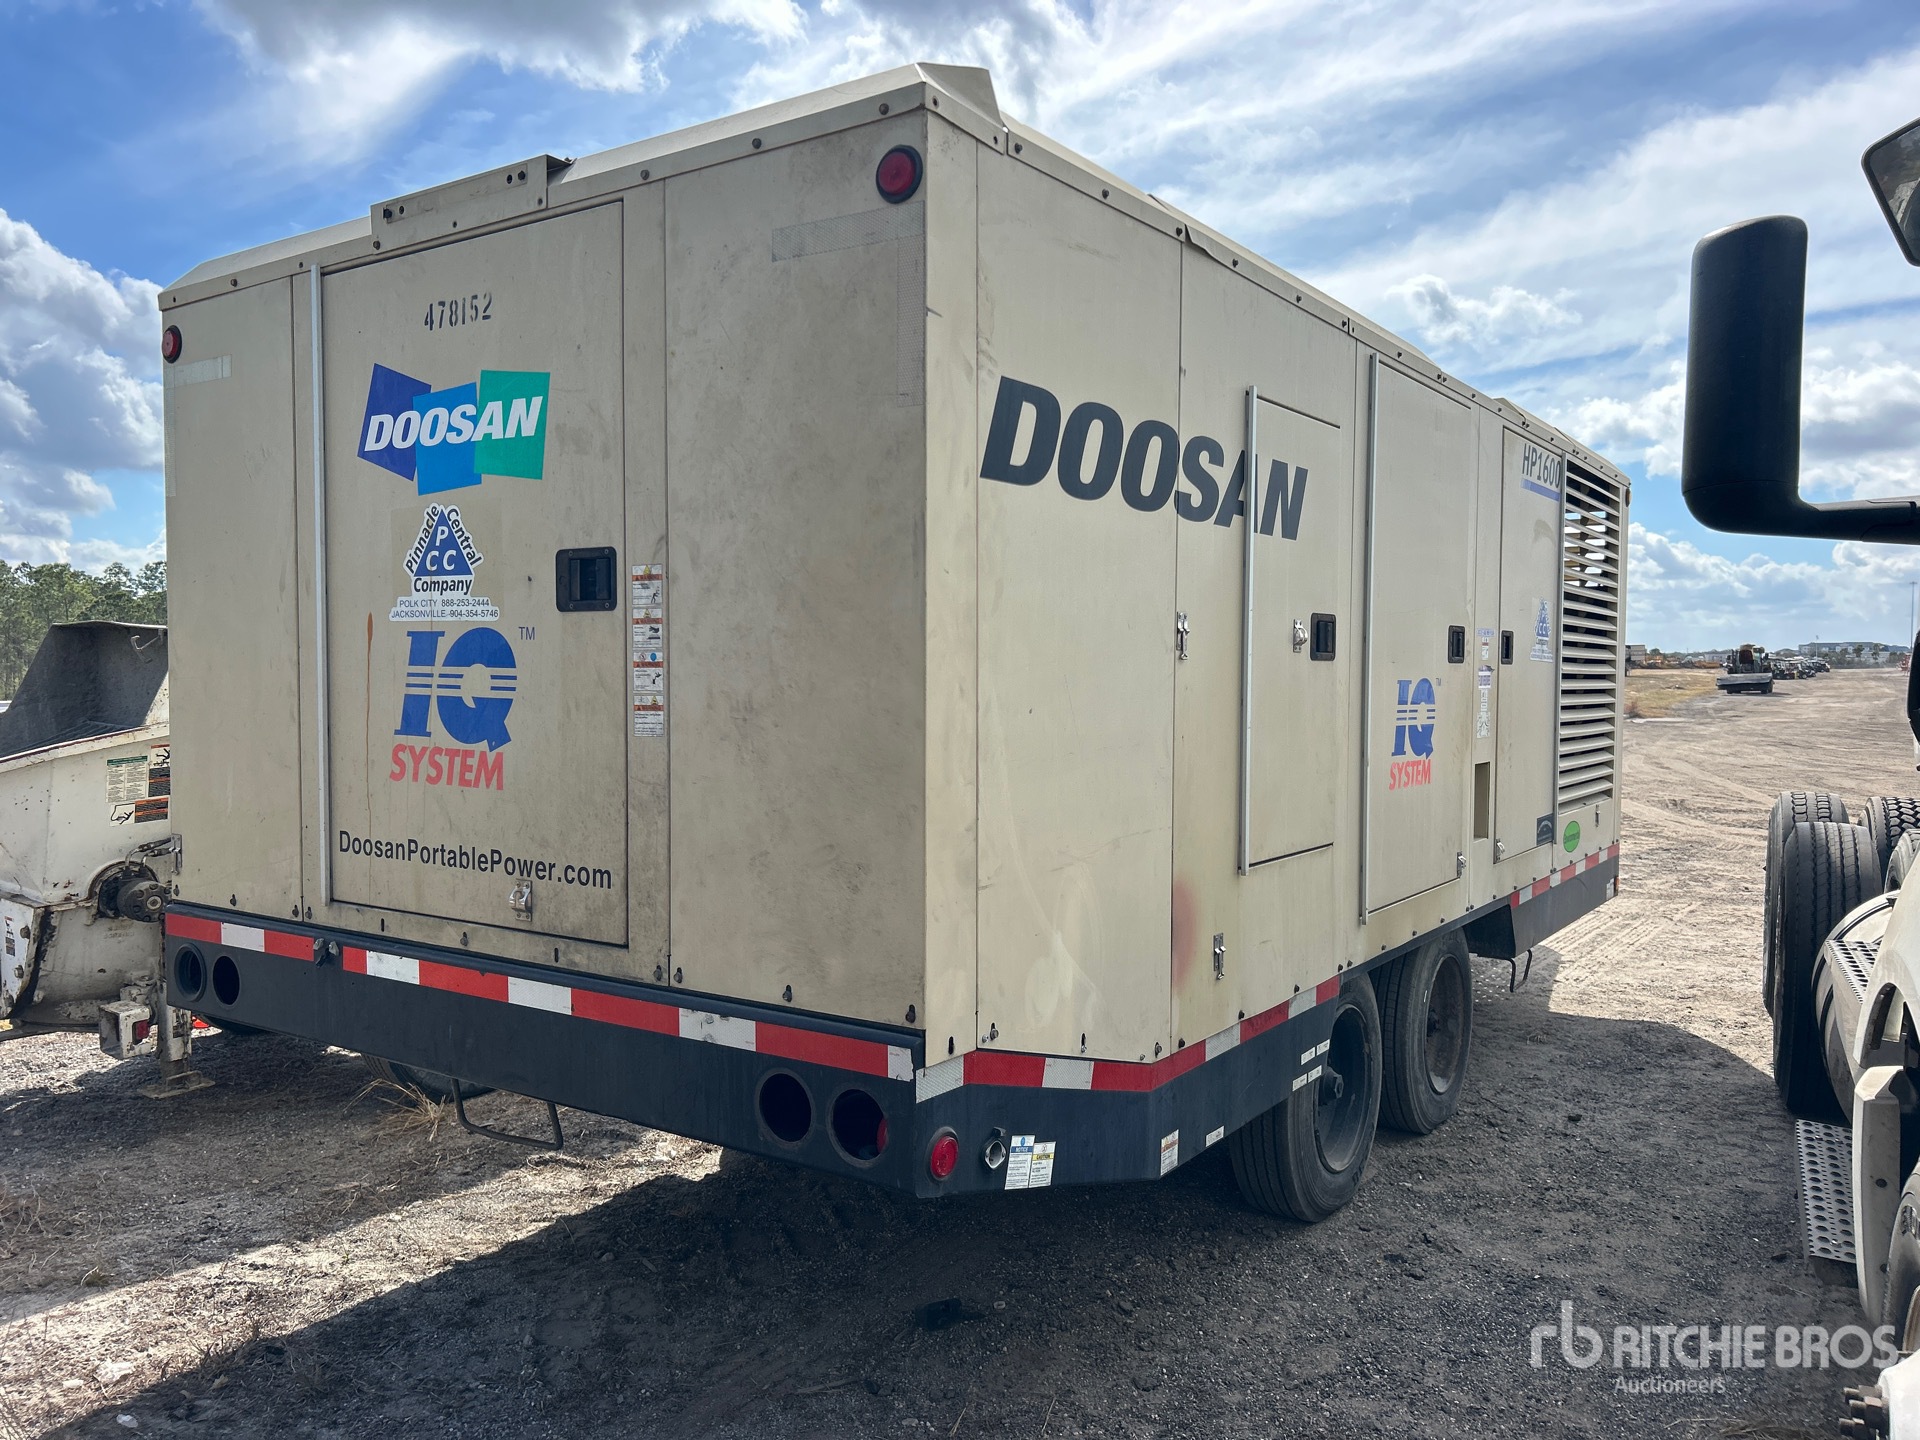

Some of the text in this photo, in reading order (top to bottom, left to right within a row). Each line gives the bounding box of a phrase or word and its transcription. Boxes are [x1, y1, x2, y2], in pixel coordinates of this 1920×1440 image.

[424, 292, 492, 331] 478152
[364, 396, 543, 452] DOOSAN
[979, 375, 1309, 541] DOOSAN
[1522, 443, 1561, 488] HP1600
[405, 505, 439, 574] Pinnacle
[435, 526, 449, 546] P
[447, 508, 482, 565] Central
[400, 599, 489, 608] POLK CITY 888-253-2444
[413, 577, 472, 595] Company
[391, 610, 446, 619] JACKSONVILLE
[394, 626, 535, 752] IQ TM
[389, 743, 504, 791] SYSTEM
[1388, 759, 1431, 791] SYSTEM
[339, 830, 612, 889] DoosanPortablePower.com
